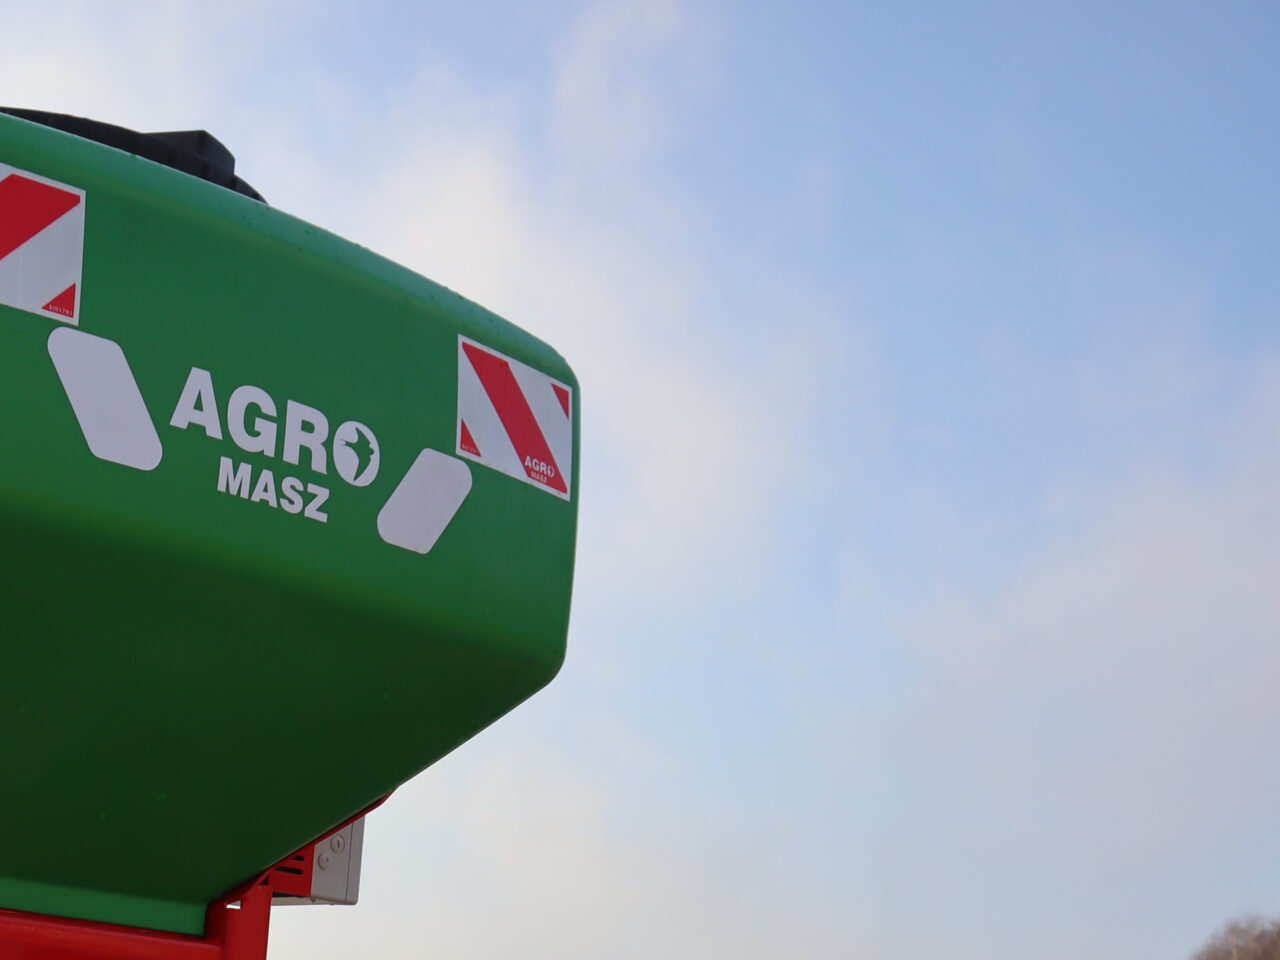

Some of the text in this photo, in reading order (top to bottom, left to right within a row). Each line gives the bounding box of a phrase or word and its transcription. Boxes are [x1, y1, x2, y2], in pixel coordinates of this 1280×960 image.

[169, 366, 381, 487] AGRO
[217, 456, 330, 523] MASZ
[524, 455, 555, 478] AGRO
